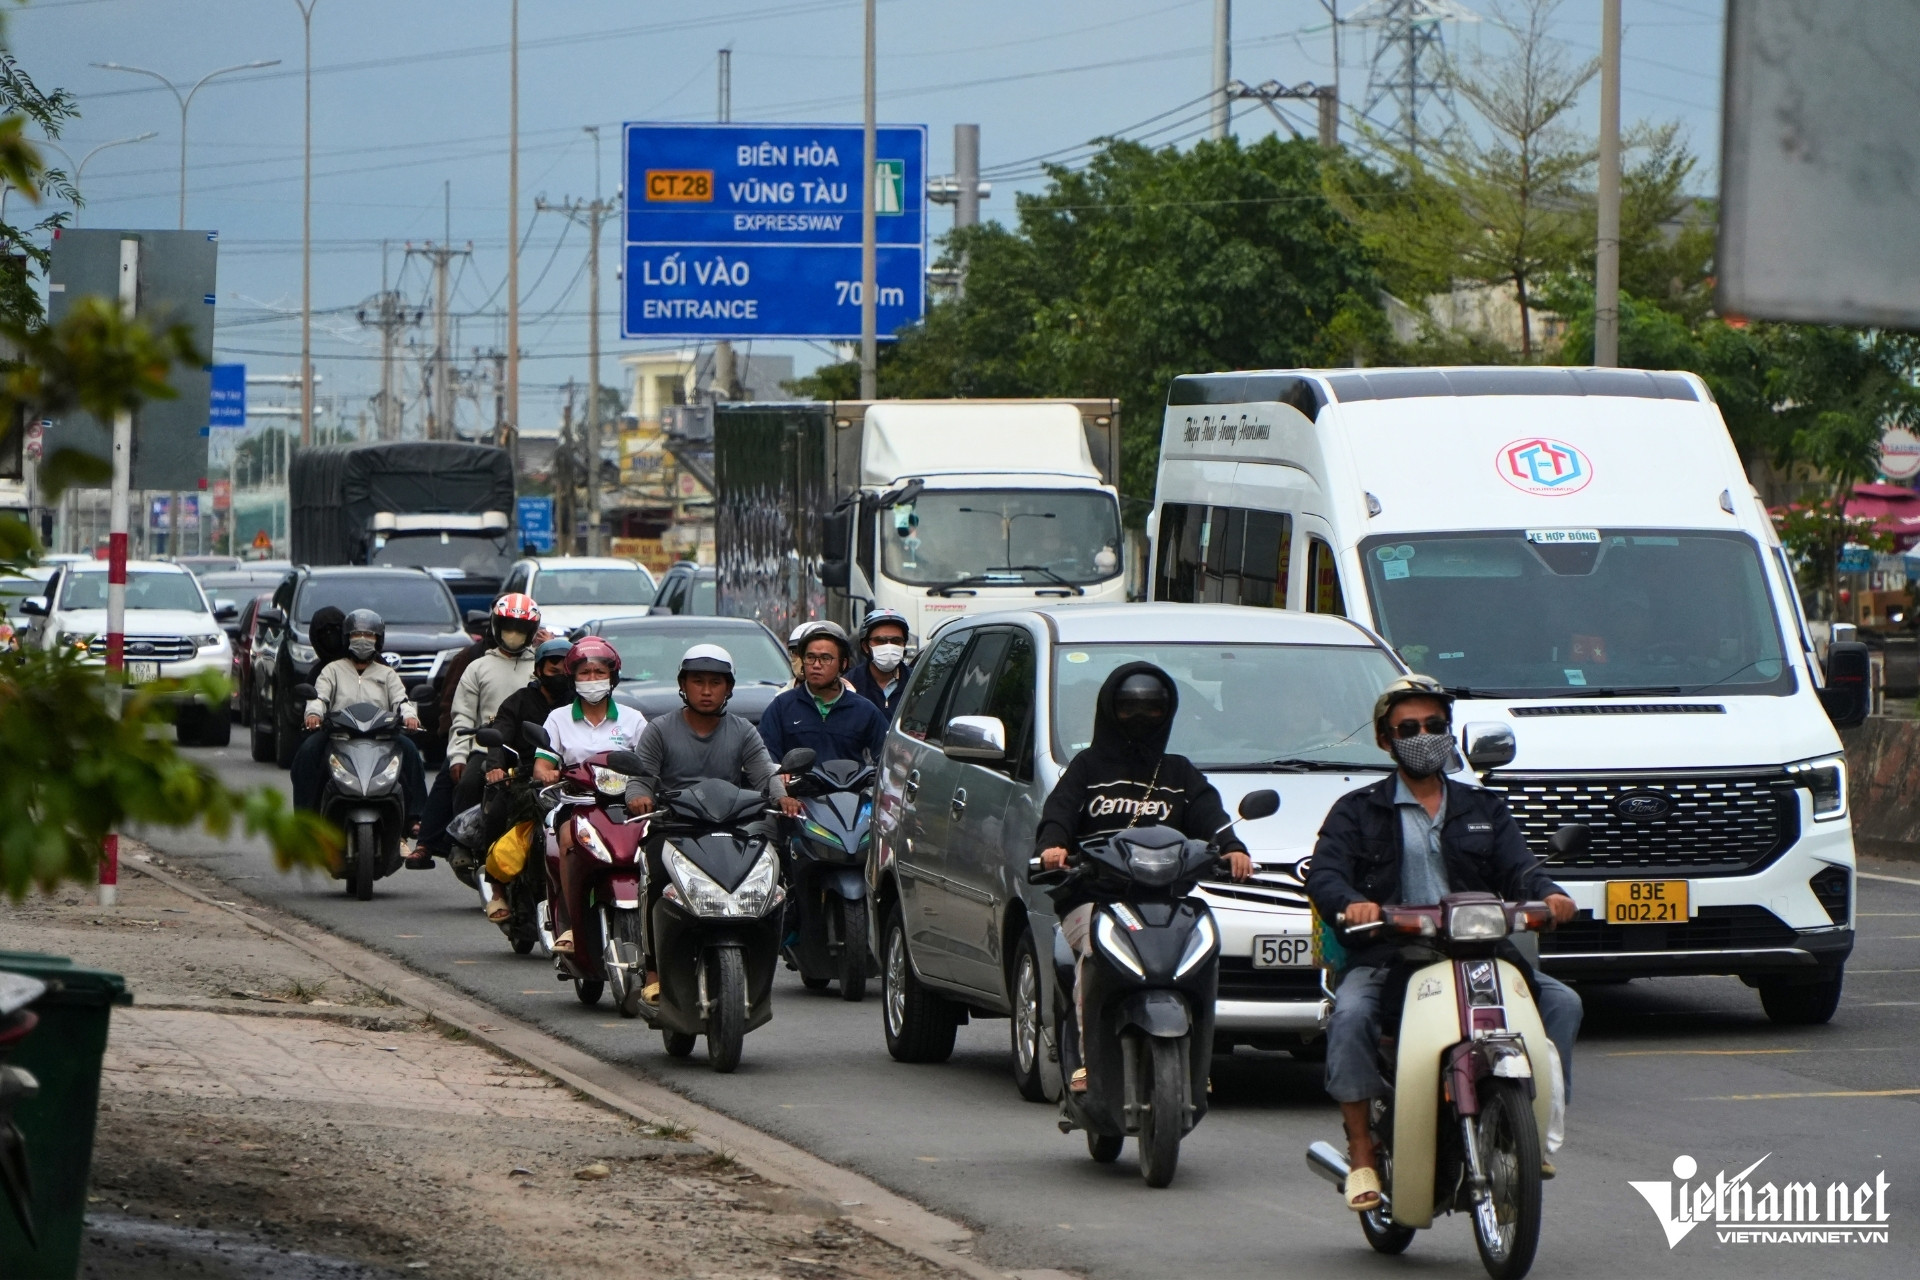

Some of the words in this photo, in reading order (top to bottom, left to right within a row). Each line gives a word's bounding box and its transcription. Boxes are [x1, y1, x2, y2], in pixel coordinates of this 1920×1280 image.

[737, 141, 787, 167] BIÊN
[794, 140, 840, 167] HÒA
[650, 175, 709, 196] CT.28
[728, 178, 795, 203] VŨNG
[801, 176, 848, 204] TÀU
[734, 214, 843, 231] EXPRESSWAY
[643, 252, 686, 286] LỐI
[694, 256, 750, 286] VÀO
[834, 281, 905, 306] 70m
[643, 300, 758, 318] ENTRANCE
[1530, 532, 1543, 541] XE
[1545, 531, 1565, 542] HỢP
[1628, 799, 1659, 813] Ford
[1630, 883, 1666, 900] 83E
[1616, 903, 1677, 921] 002.21
[1262, 939, 1309, 964] 56P
